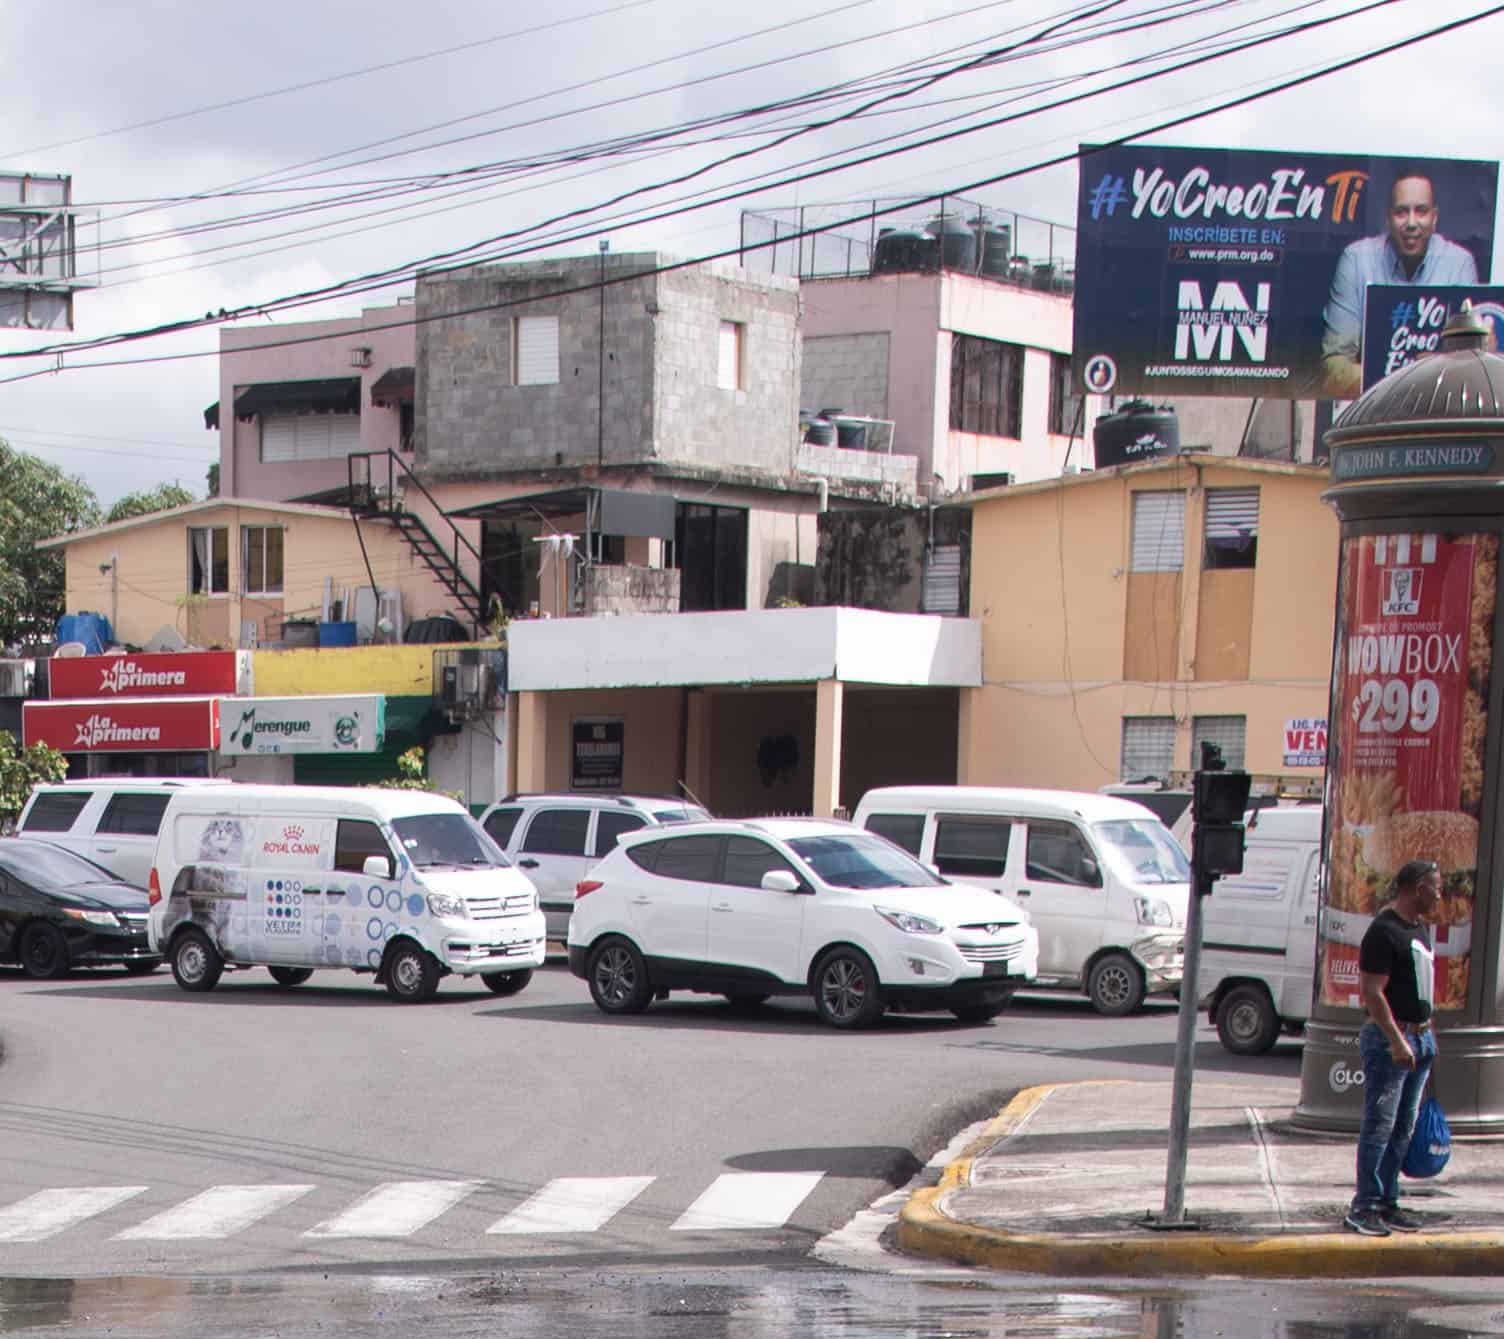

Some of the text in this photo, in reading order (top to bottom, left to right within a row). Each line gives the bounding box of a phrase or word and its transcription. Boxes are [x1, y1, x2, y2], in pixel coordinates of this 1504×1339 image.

[1189, 248, 1274, 264] www.prm.org.do
[1178, 311, 1224, 326] MANUEL
[1391, 327, 1440, 352] Creo
[1144, 365, 1290, 379] #JUNTOSSEGUIMOSAVANZANDO
[1406, 447, 1484, 467] KENNEDY
[1388, 602, 1415, 613] KFC
[119, 660, 136, 674] La
[118, 667, 185, 691] primera
[1351, 679, 1441, 733] $299
[94, 715, 111, 729] La
[230, 707, 311, 750] Merengue
[92, 723, 160, 747] primera
[263, 842, 320, 855] ROYAL CANIN
